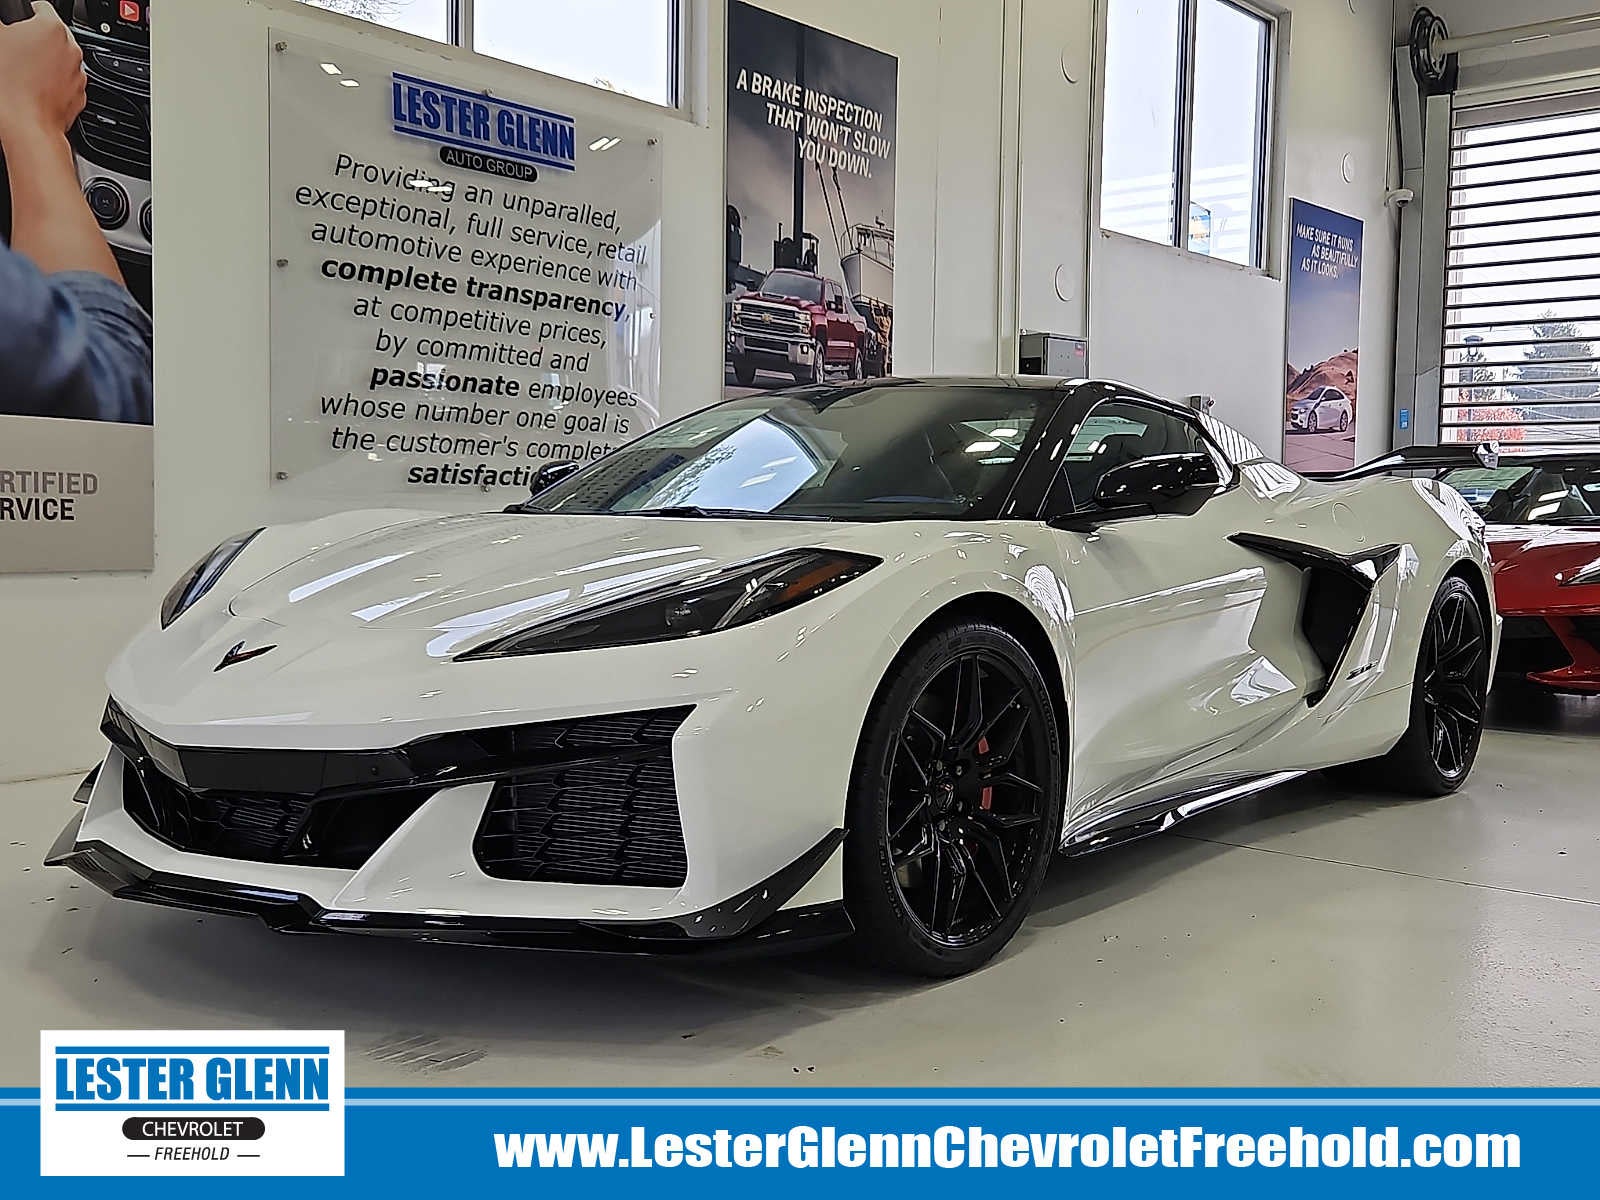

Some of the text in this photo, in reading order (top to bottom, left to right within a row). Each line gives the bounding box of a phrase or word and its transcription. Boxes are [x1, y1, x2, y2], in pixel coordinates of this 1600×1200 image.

[736, 69, 882, 132] A BRAKE INSPECTION
[394, 83, 574, 161] LESTER GLENN
[766, 102, 891, 158] THAT WON'T SLOW
[446, 150, 533, 180] AUTO GROUP
[798, 138, 872, 178] YOU DOWN.
[335, 153, 621, 234] Providing an unparalled,
[296, 184, 647, 266] exceptional, full service, retail
[1296, 224, 1314, 240] MAKE
[1314, 229, 1330, 246] SURE
[1330, 234, 1338, 246] IT
[312, 220, 638, 292] automotive experience with
[1301, 257, 1310, 272] AS
[1310, 260, 1318, 273] IT
[1311, 244, 1358, 268] AS BEAUTIFULLY
[321, 258, 630, 322] complete transparency,
[354, 296, 608, 349] at competitive prices,
[376, 328, 590, 373] by committed and
[370, 366, 638, 408] passionate employees
[321, 393, 630, 435] whose number one goal is
[331, 426, 375, 452] the
[386, 432, 518, 457] customer's
[0, 470, 98, 494] RTIFIED
[408, 462, 538, 488] satisfacti
[0, 498, 75, 520] RVICE
